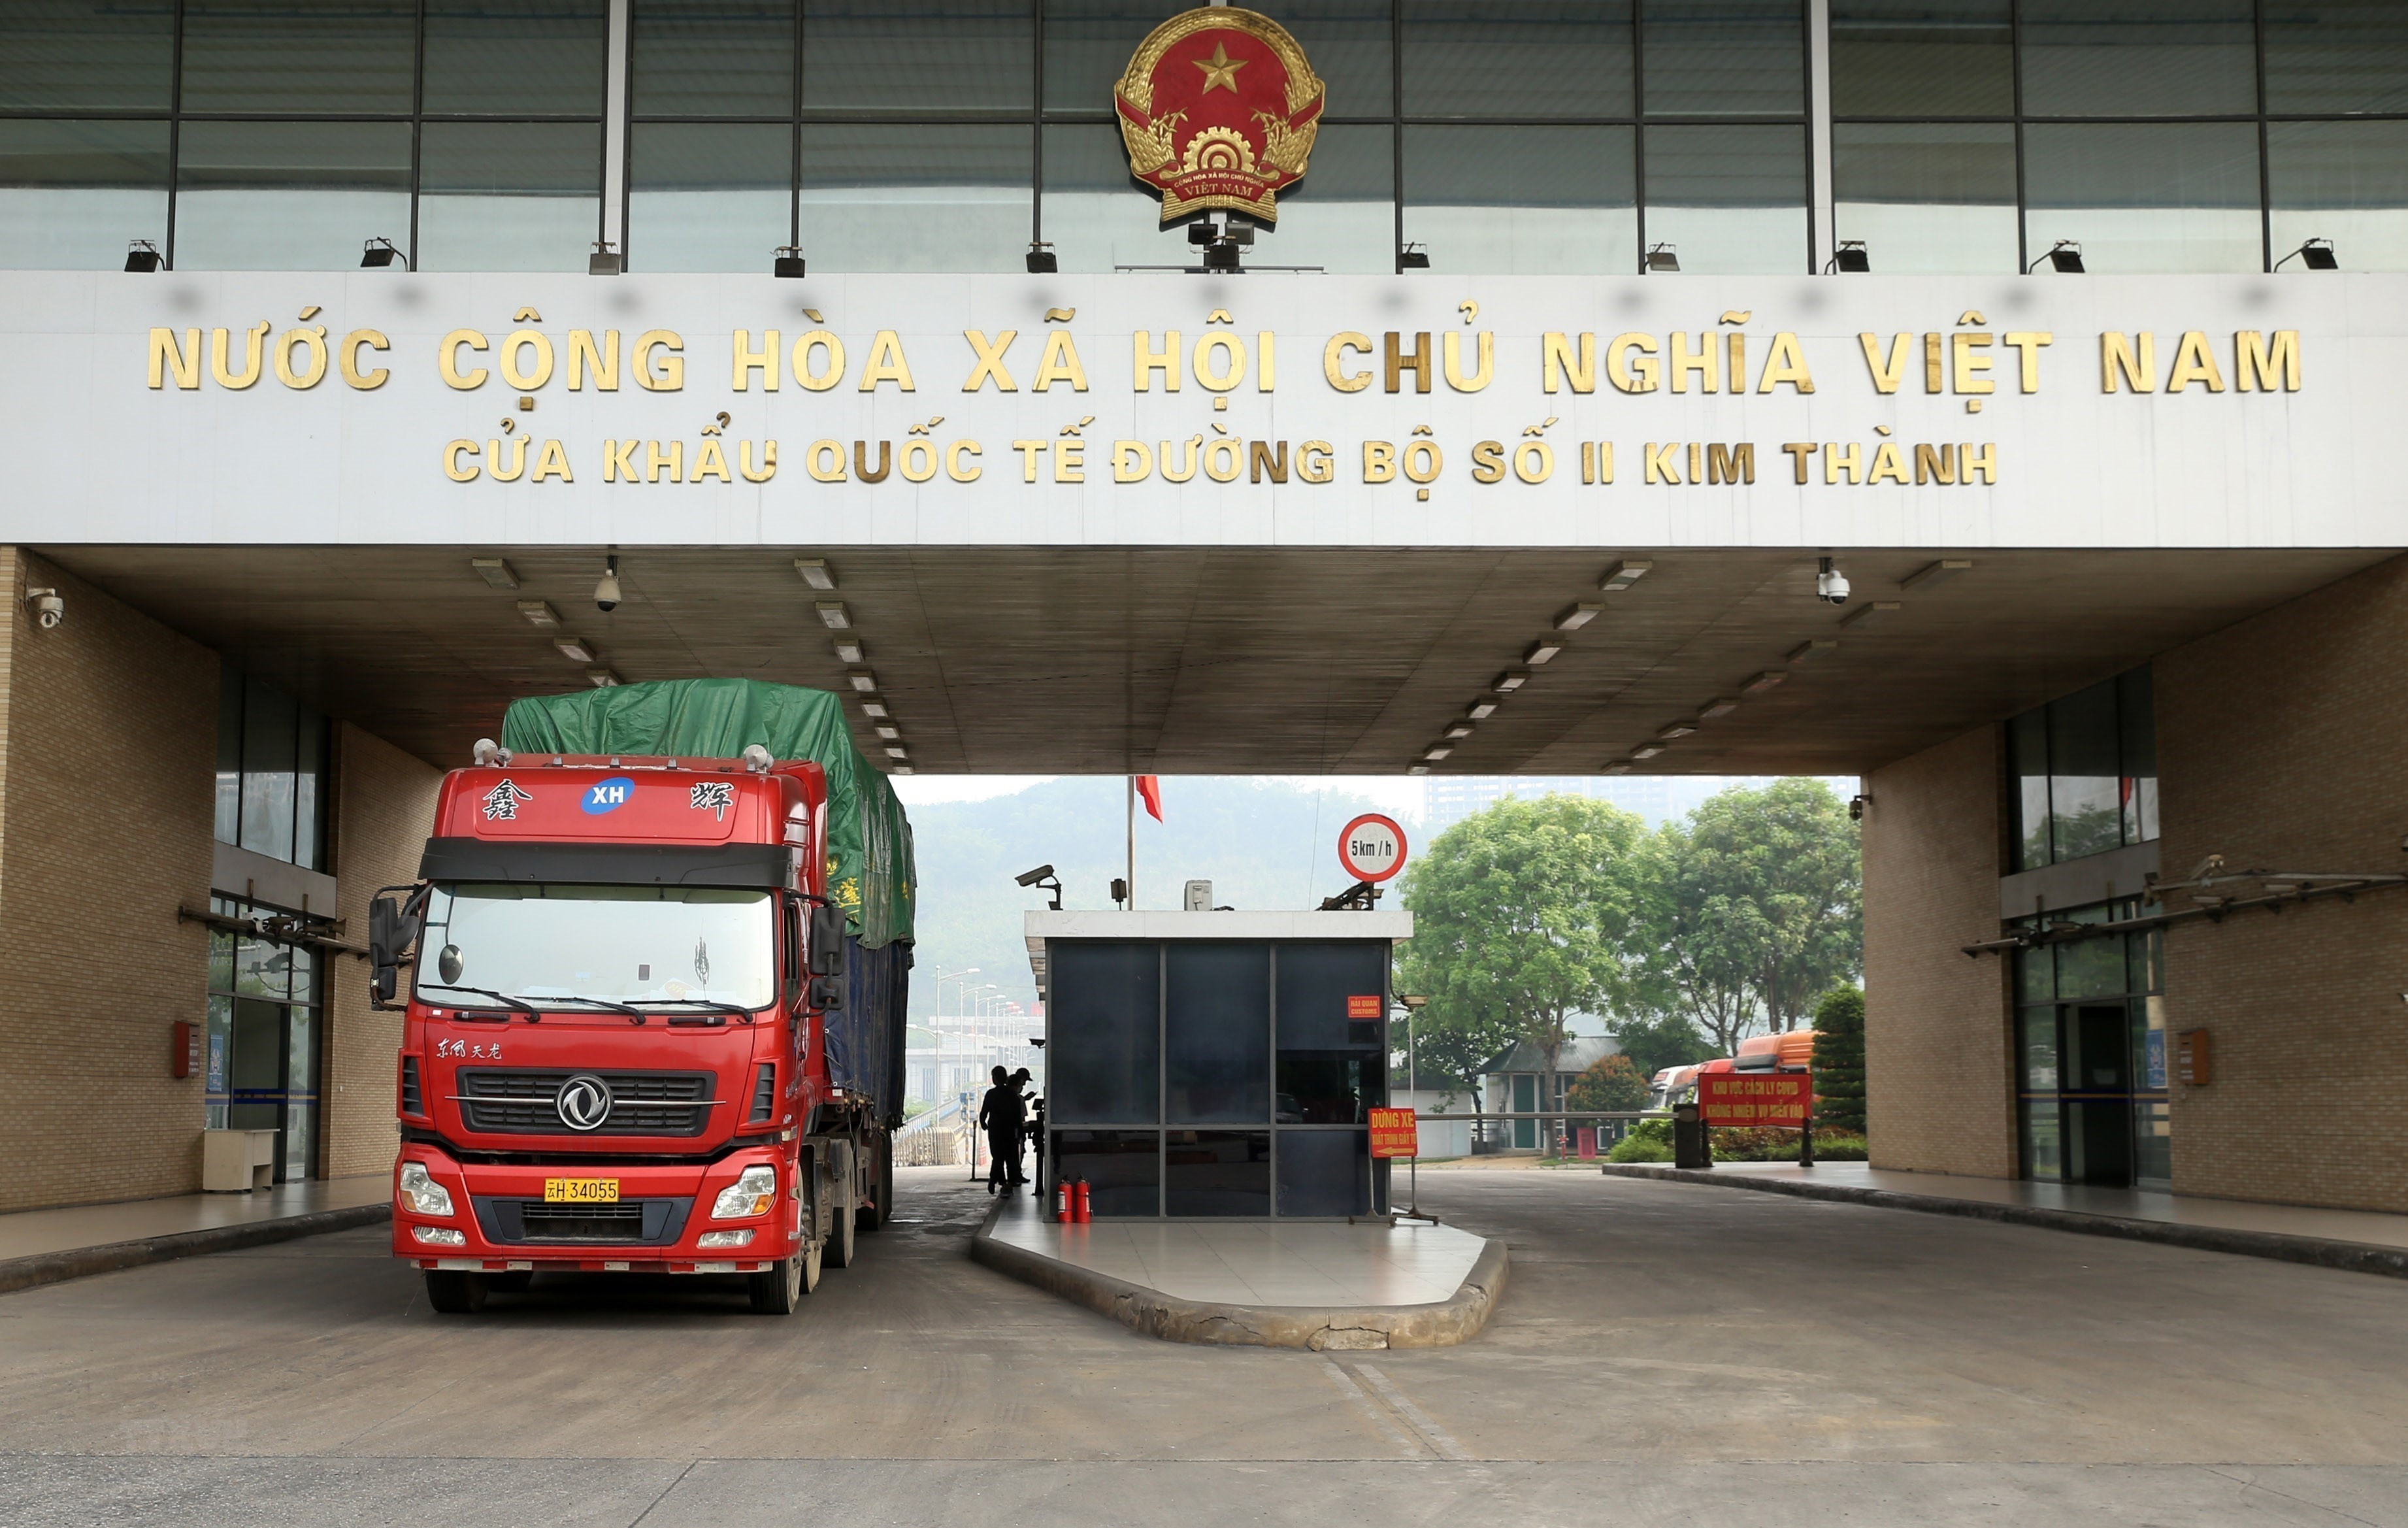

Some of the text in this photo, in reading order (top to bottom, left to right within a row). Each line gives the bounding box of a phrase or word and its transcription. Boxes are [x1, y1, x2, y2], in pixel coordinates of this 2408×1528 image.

[1222, 184, 1253, 196] NAM
[147, 299, 2301, 413] NƯỚC CỘNG HÒA XÃ HỘI CHỦ NGHĨA VIỆT NAM
[442, 412, 1997, 501] CỬA KHẨU QUỐC TẾ ĐƯỜNG BỘ SỐ II KIM THÀNH
[483, 778, 734, 822] 鑫 XH 辉
[1766, 1082, 1775, 1095] LY
[1776, 1082, 1798, 1095] COVID
[1372, 1108, 1414, 1128] DỪNG XE
